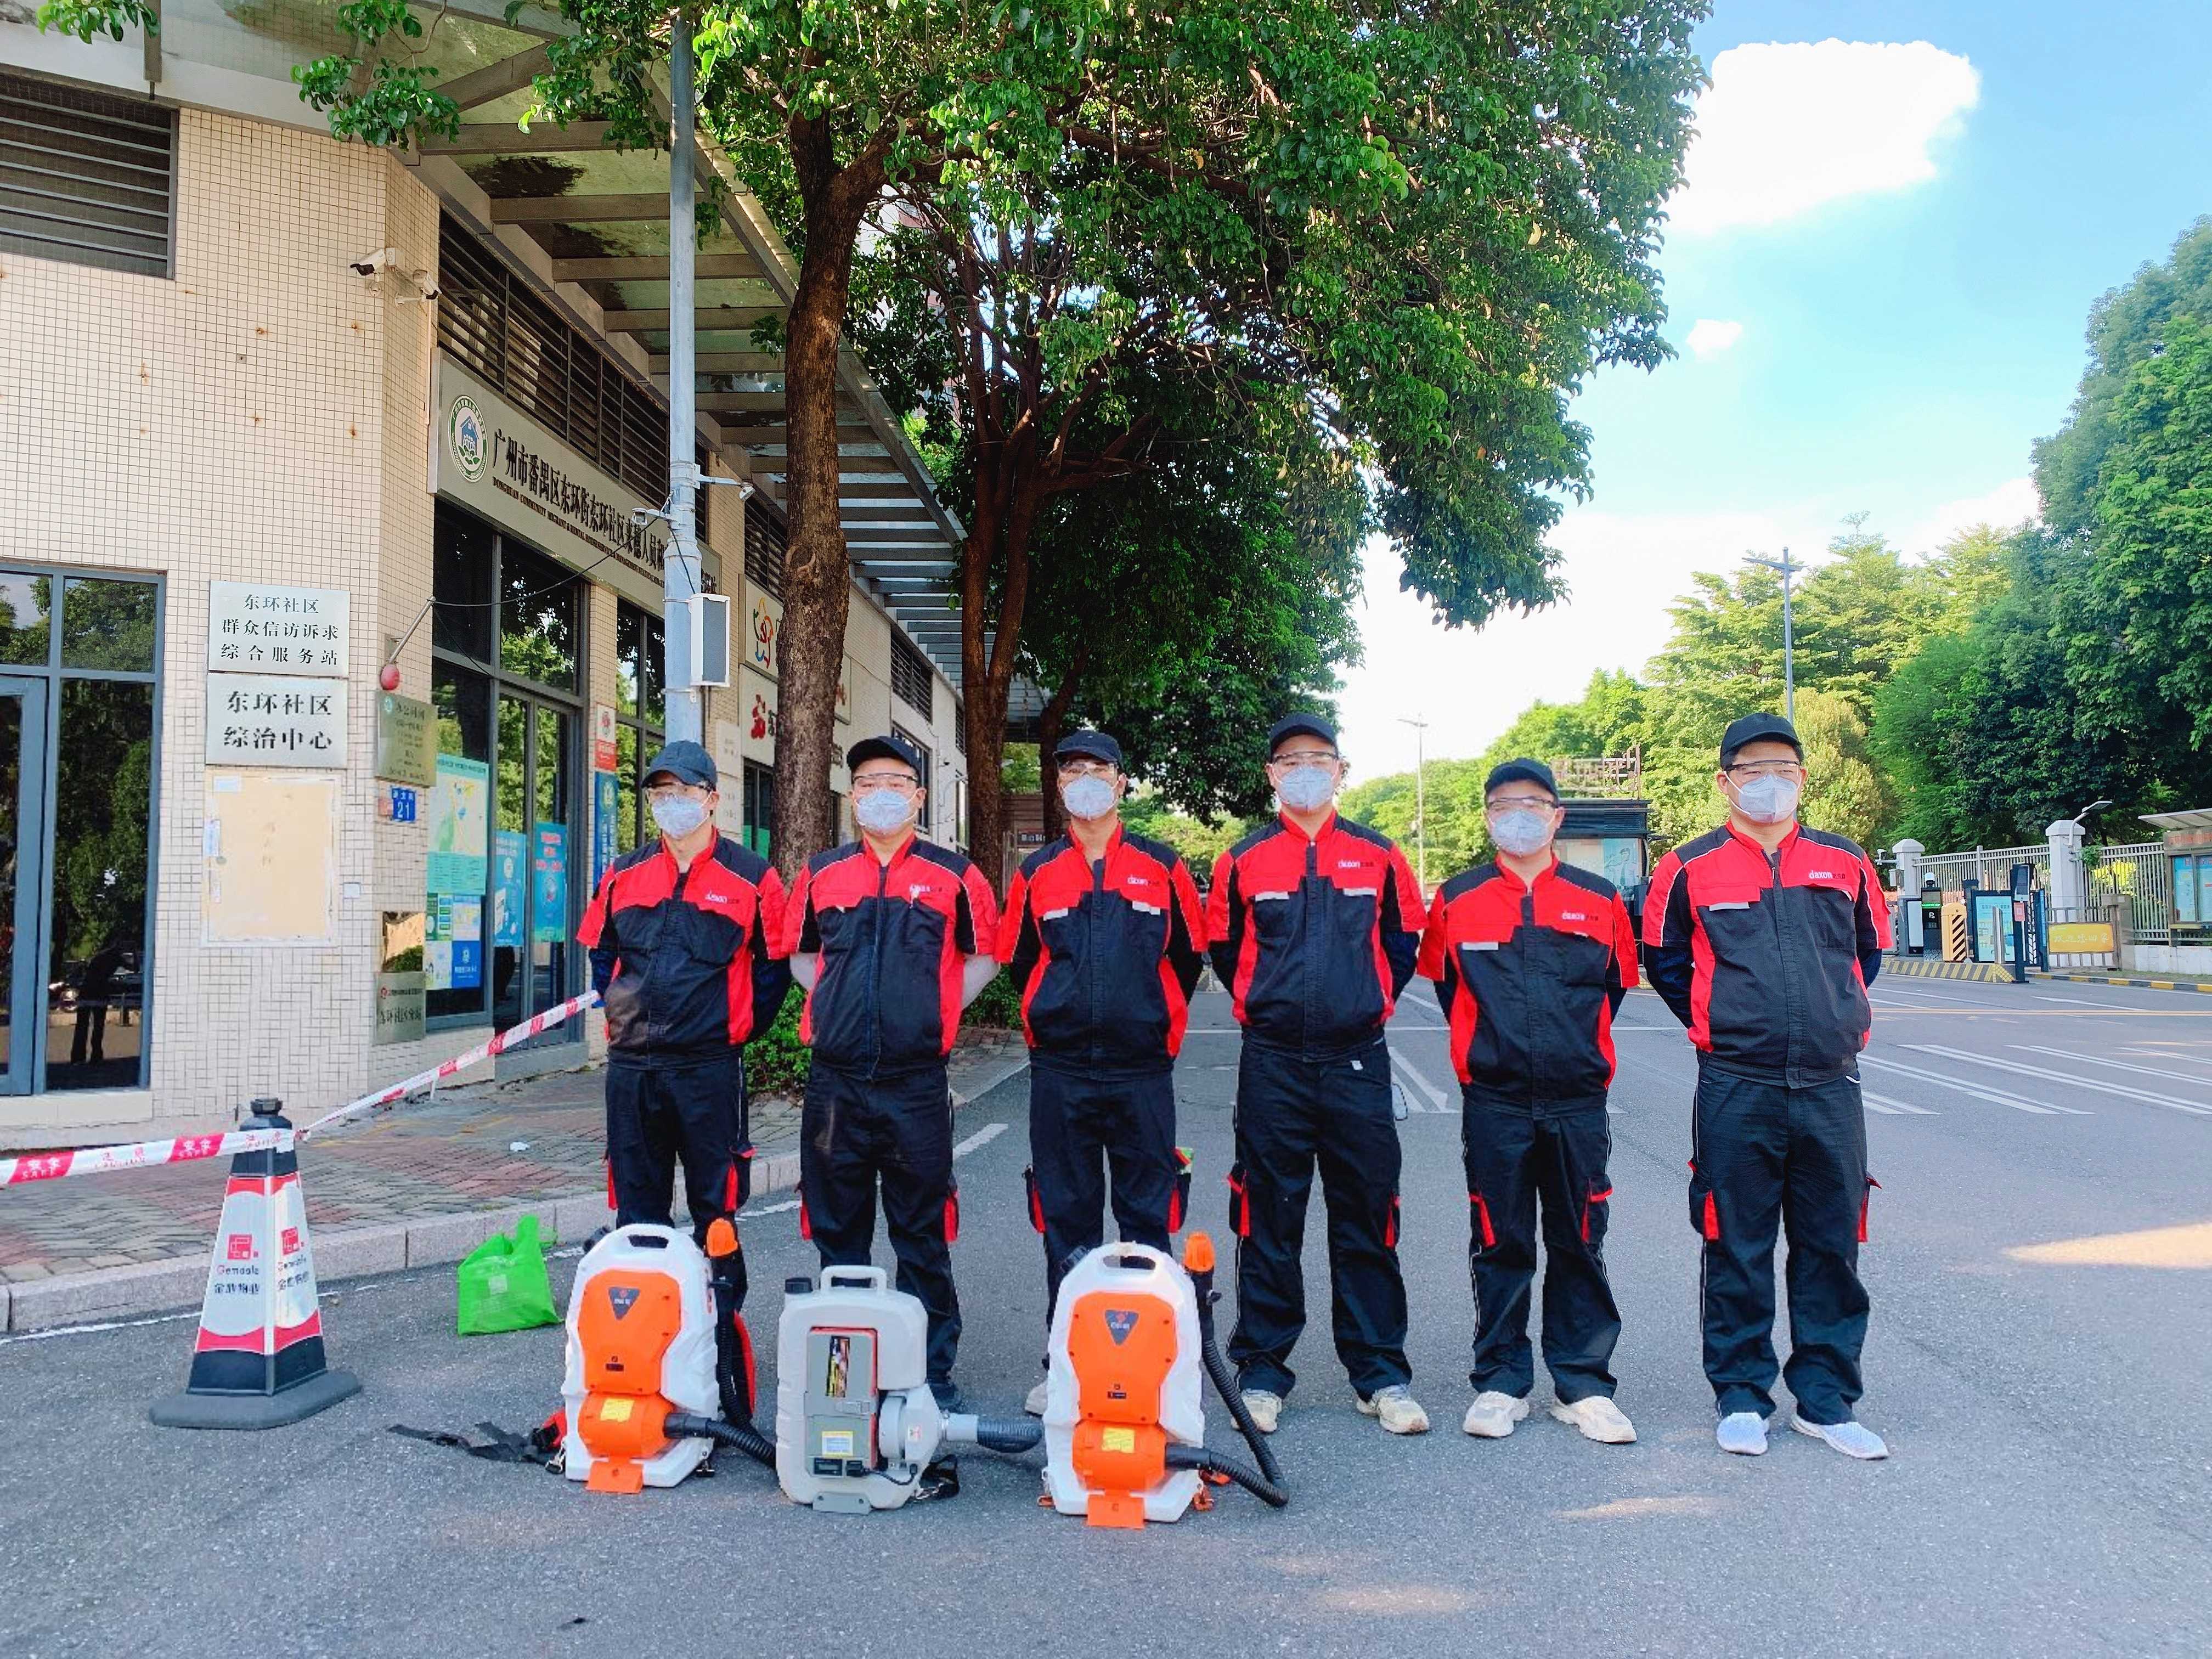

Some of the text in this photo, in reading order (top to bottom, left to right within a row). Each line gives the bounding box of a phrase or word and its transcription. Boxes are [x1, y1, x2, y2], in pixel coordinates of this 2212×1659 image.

[243, 594, 319, 613] 东环社区
[222, 618, 338, 641] 群众信访诉求
[221, 643, 337, 665] 综合服务站
[227, 691, 332, 715] 东环社区
[223, 726, 332, 751] 综治中心
[397, 801, 409, 820] 21
[1809, 870, 1833, 879] daxon
